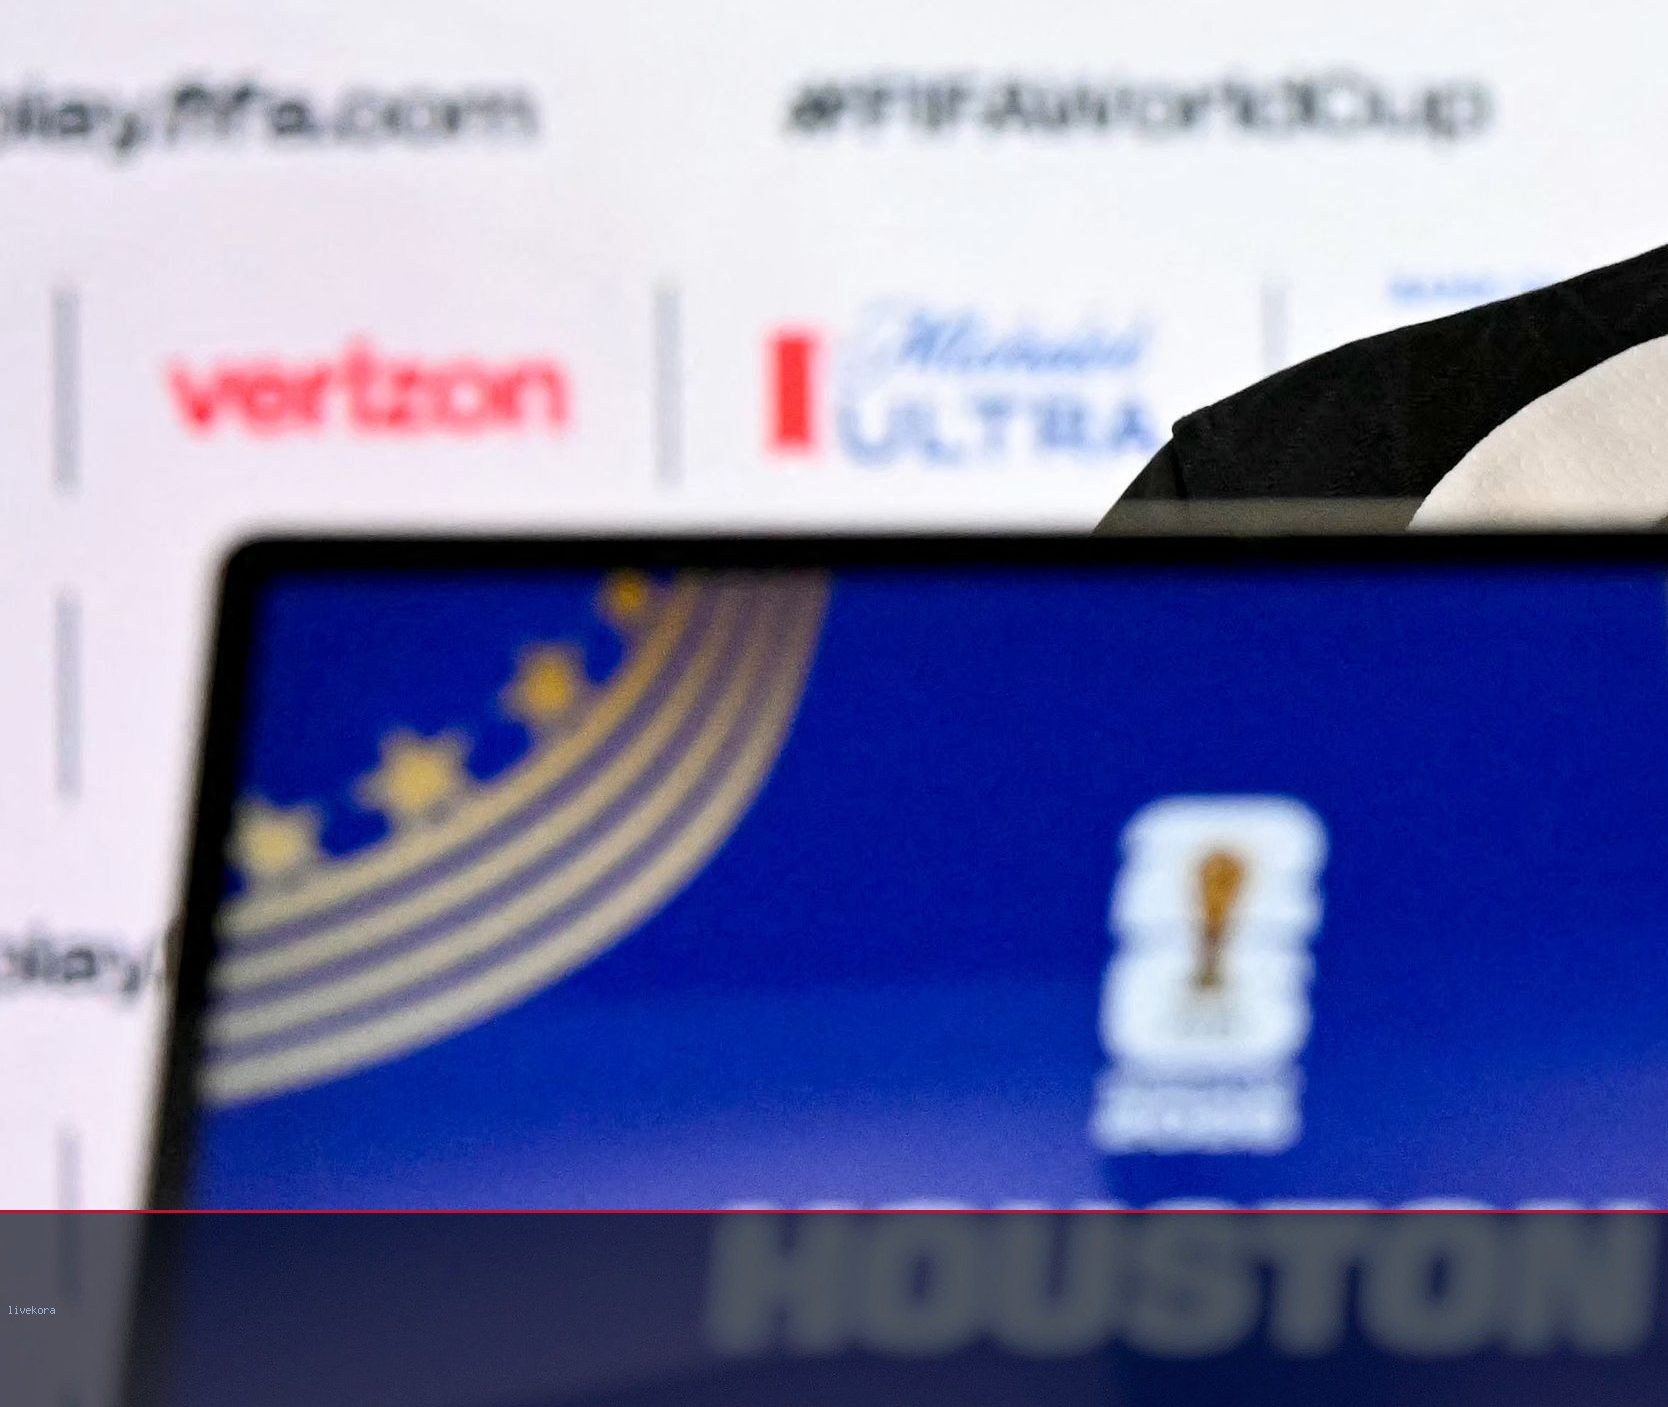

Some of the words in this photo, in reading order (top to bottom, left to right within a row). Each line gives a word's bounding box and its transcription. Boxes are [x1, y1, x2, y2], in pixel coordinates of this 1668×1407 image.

[783, 70, 1494, 145] #FIFAWorldCup
[166, 338, 571, 438] verizon
[836, 390, 1159, 461] ULTRA
[704, 1197, 1659, 1357] HOUSTON
